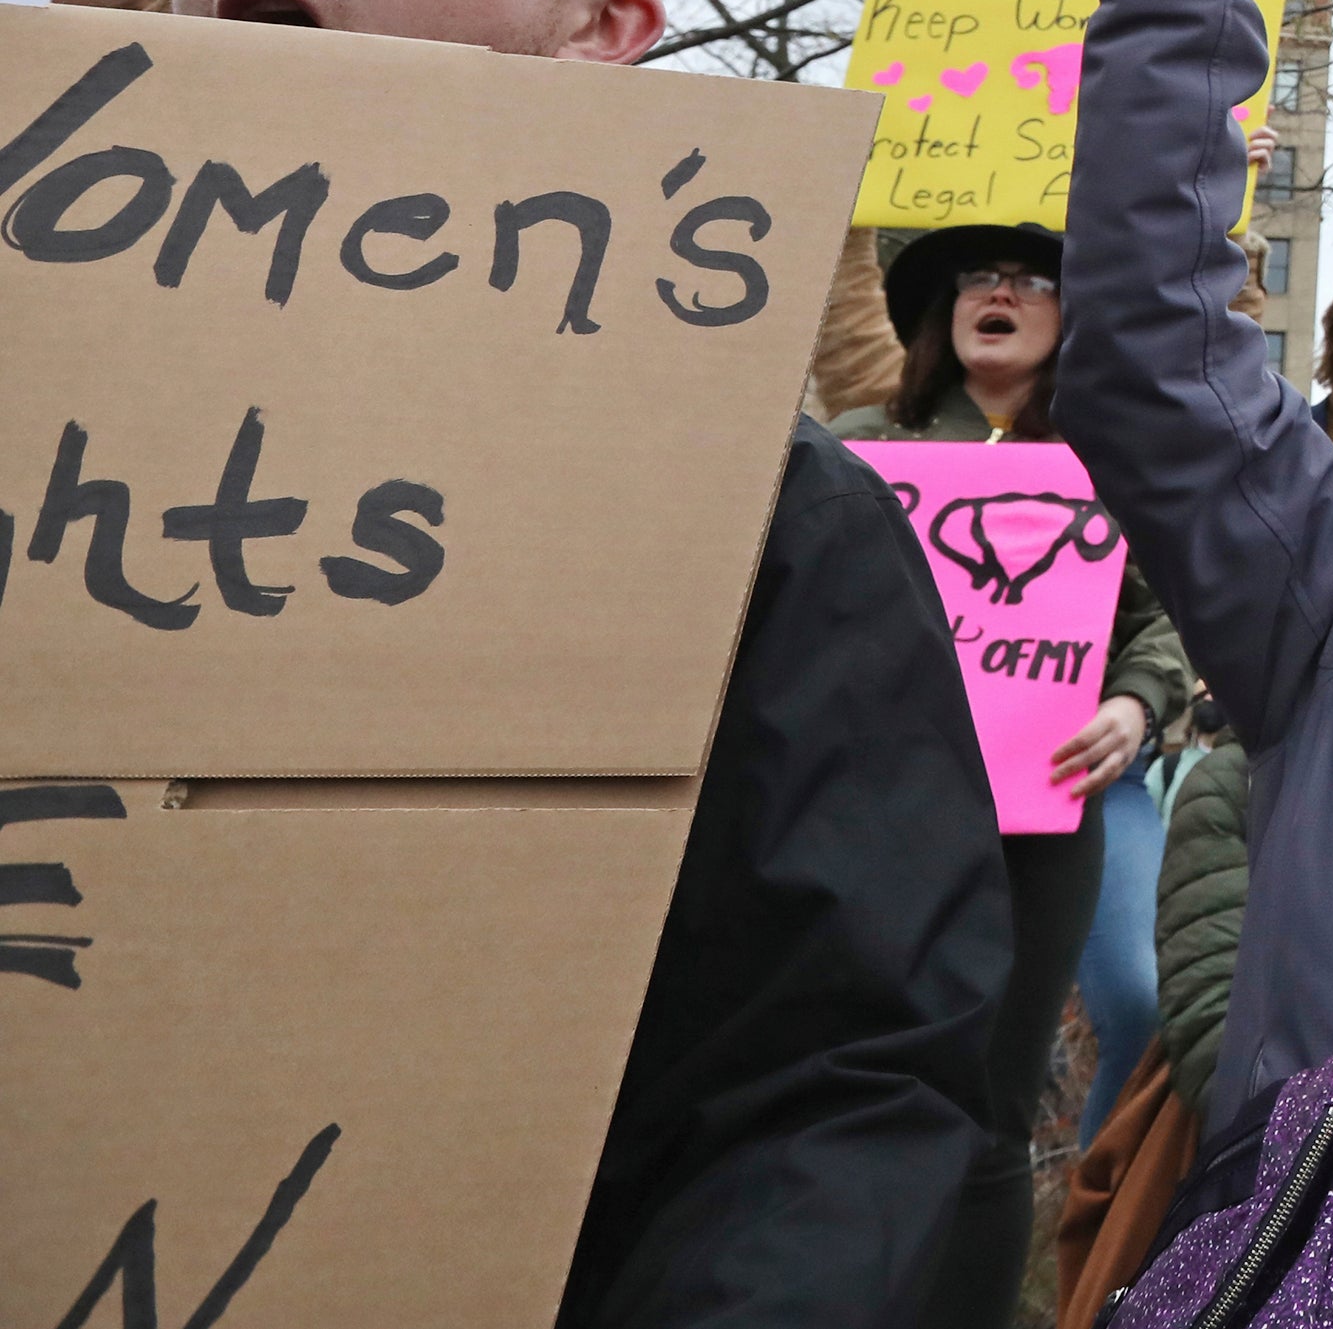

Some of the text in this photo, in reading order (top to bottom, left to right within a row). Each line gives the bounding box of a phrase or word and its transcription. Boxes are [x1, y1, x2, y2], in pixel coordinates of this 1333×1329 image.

[869, 114, 980, 160] rotect
[889, 167, 997, 221] Legal
[0, 407, 445, 629] hts
